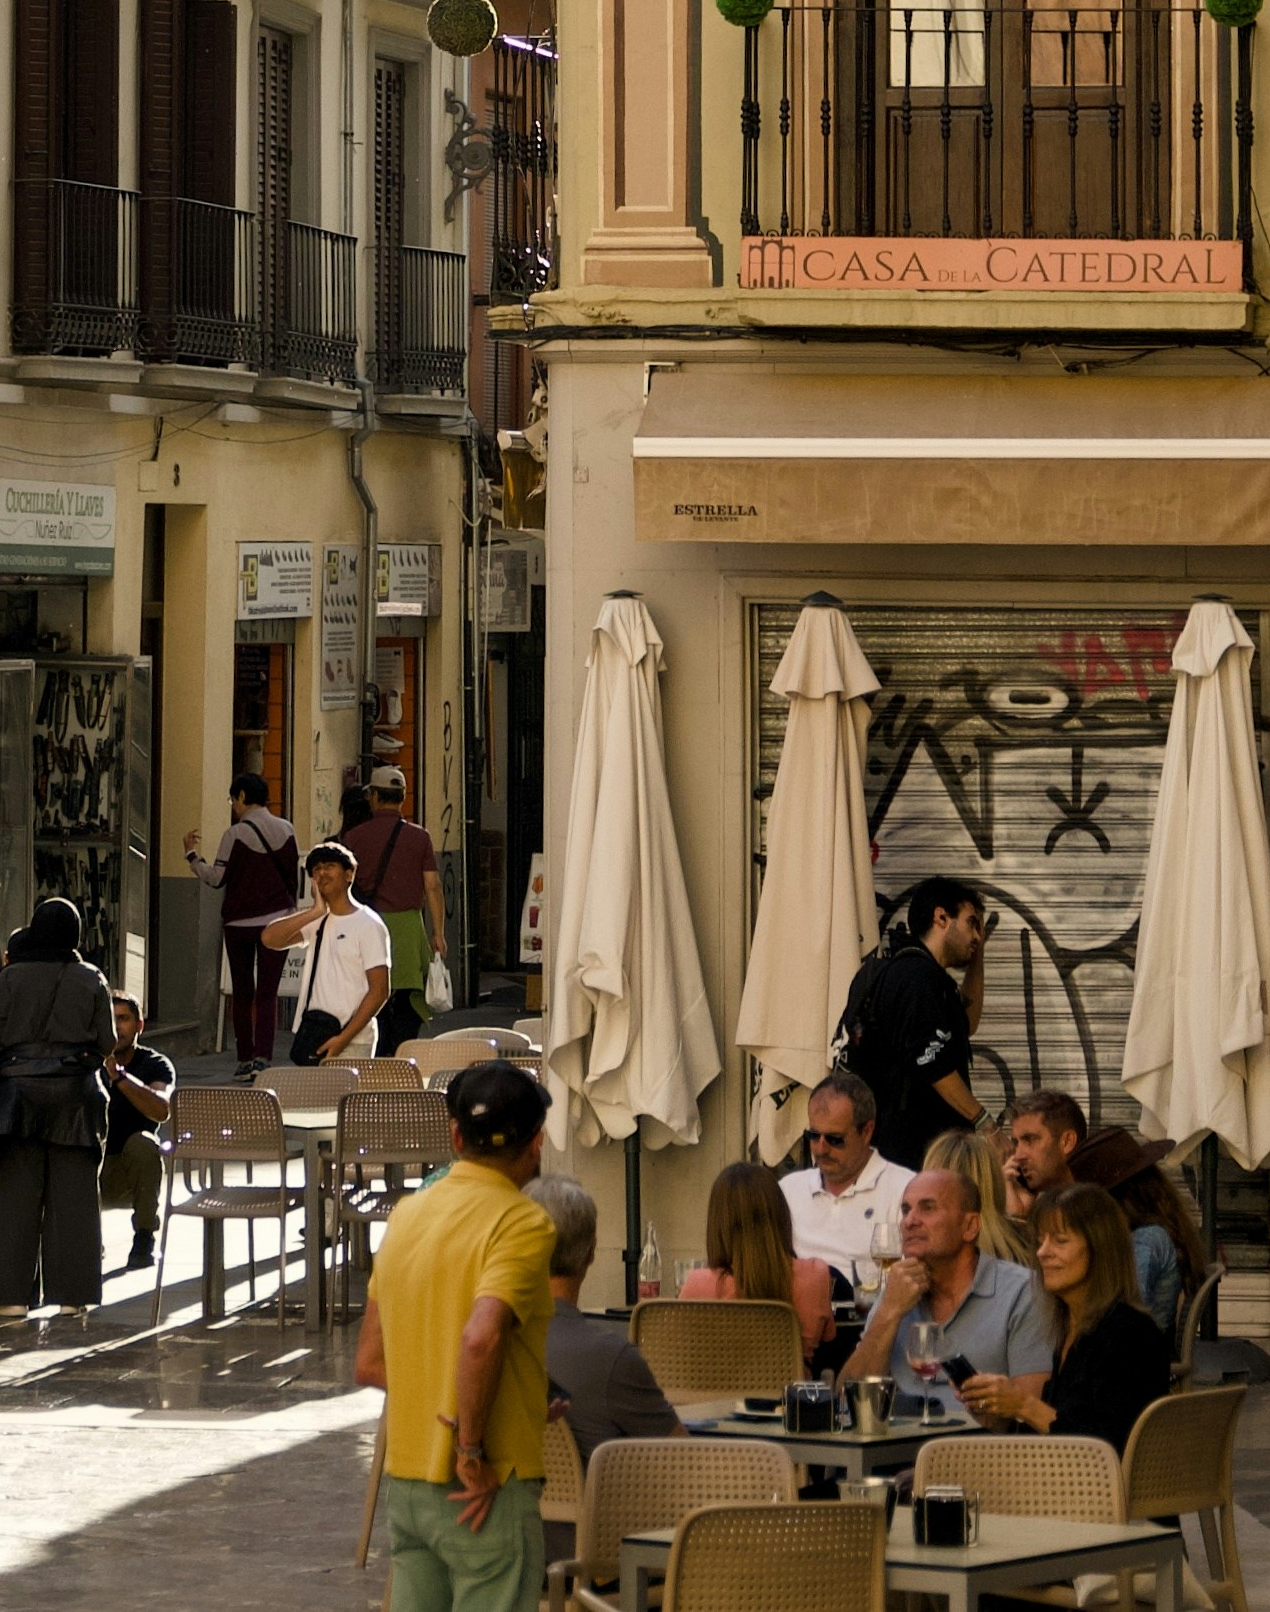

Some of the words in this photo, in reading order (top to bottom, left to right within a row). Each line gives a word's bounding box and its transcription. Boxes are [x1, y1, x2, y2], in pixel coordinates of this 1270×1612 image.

[802, 249, 931, 283] CASA
[937, 269, 959, 283] DE
[962, 269, 983, 283] LA
[985, 245, 1227, 285] CATEDRAL
[673, 504, 759, 516] ESTRELLA
